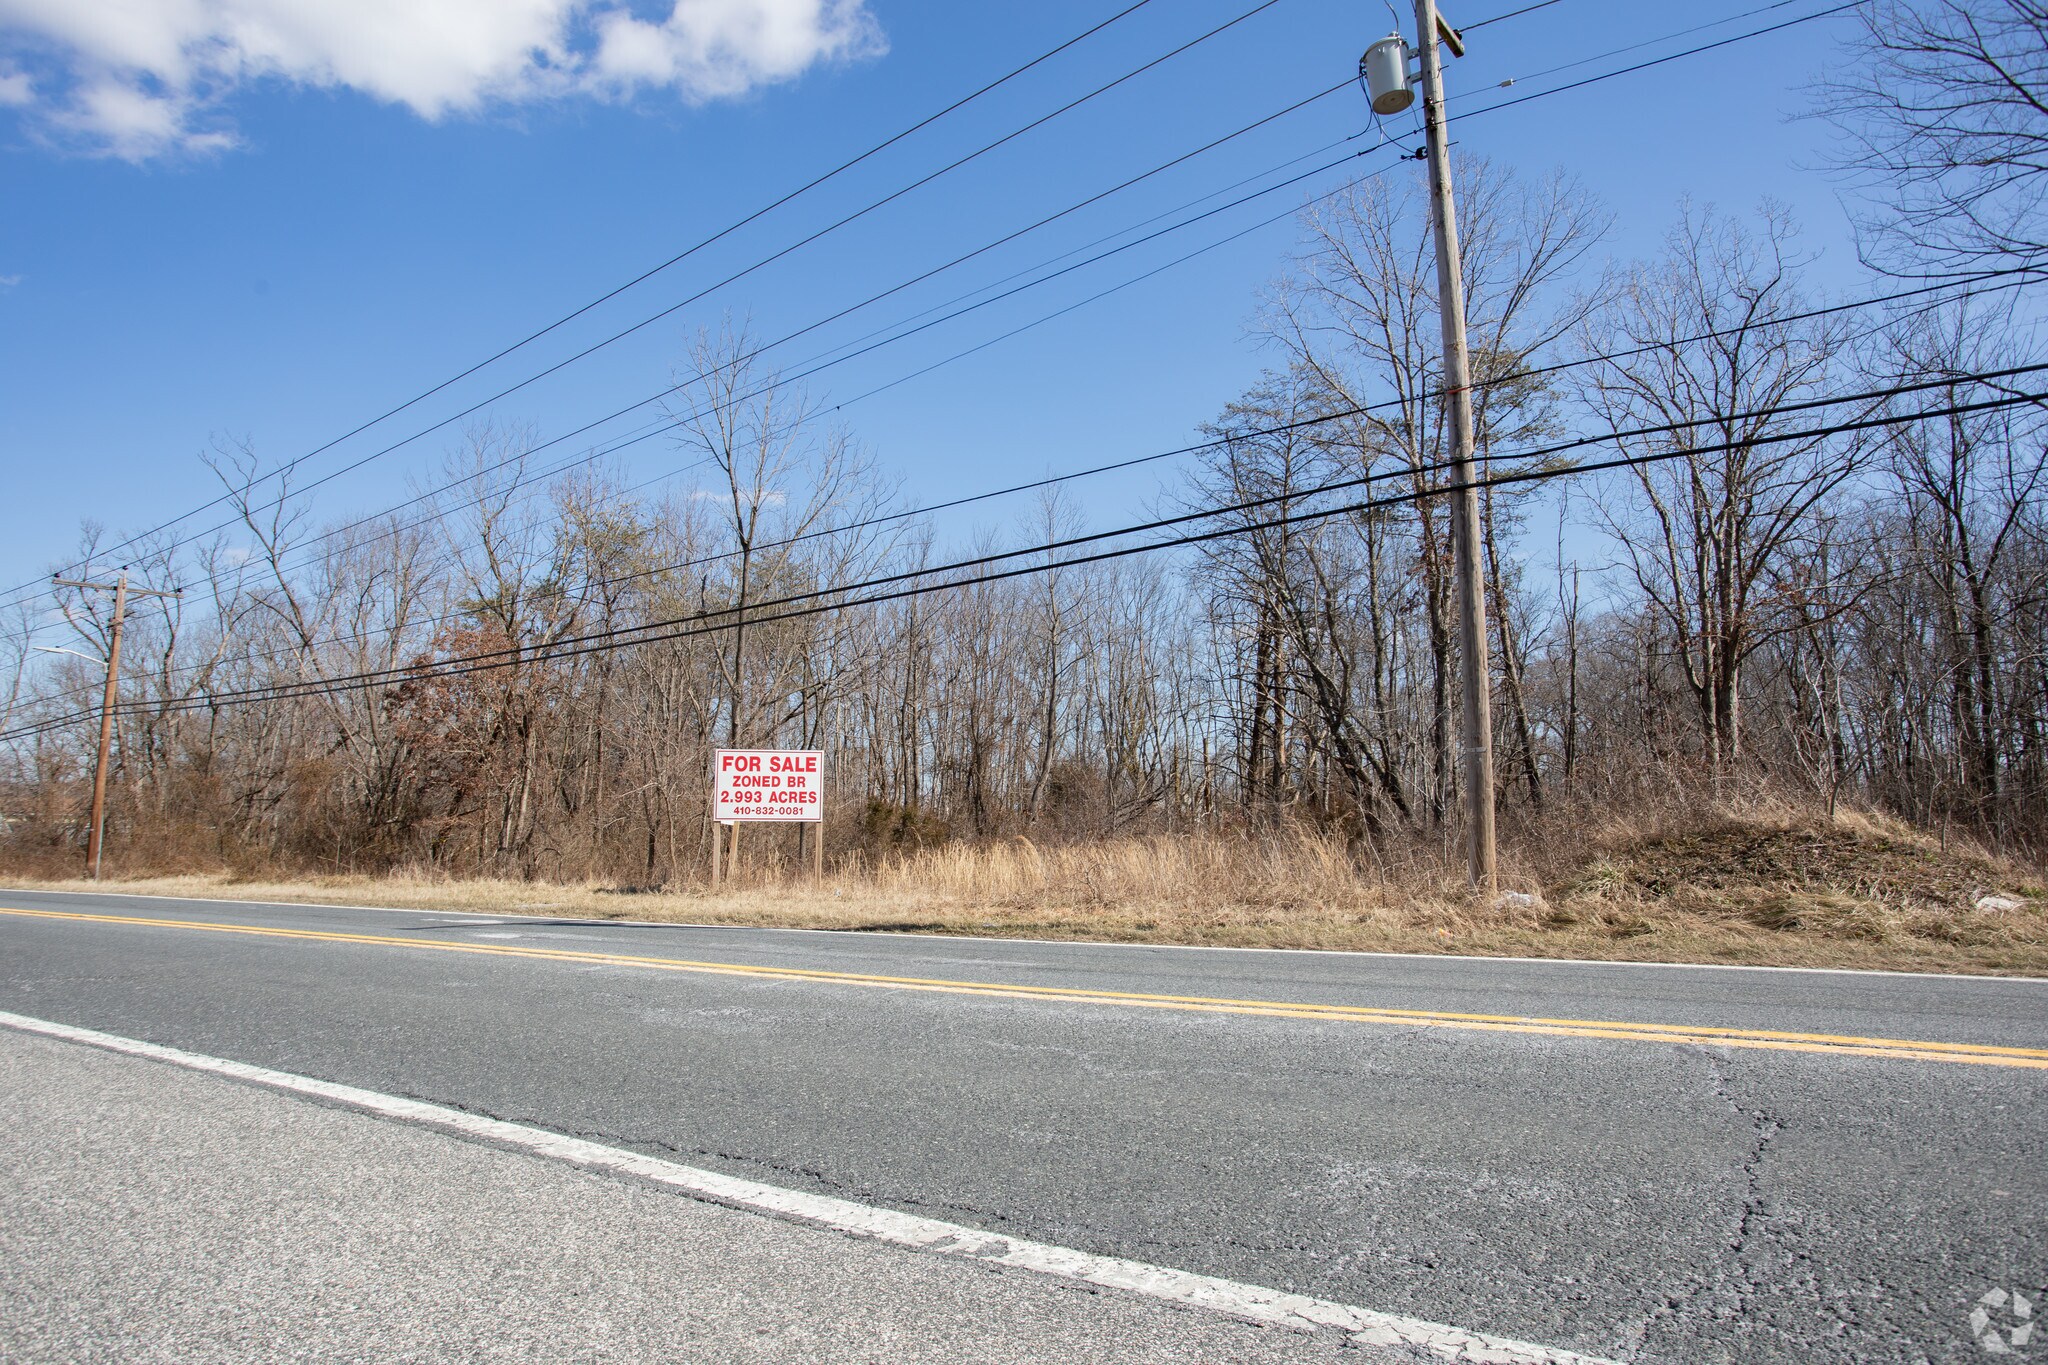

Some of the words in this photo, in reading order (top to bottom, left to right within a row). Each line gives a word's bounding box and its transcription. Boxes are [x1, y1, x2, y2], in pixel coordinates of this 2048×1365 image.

[722, 756, 761, 772] FOR
[769, 756, 817, 772] SALE
[732, 775, 781, 787] ZONED
[787, 776, 806, 788] BR
[720, 790, 762, 803] 2.993
[768, 791, 817, 804] ACRES
[733, 806, 804, 815] 410-832-0081
